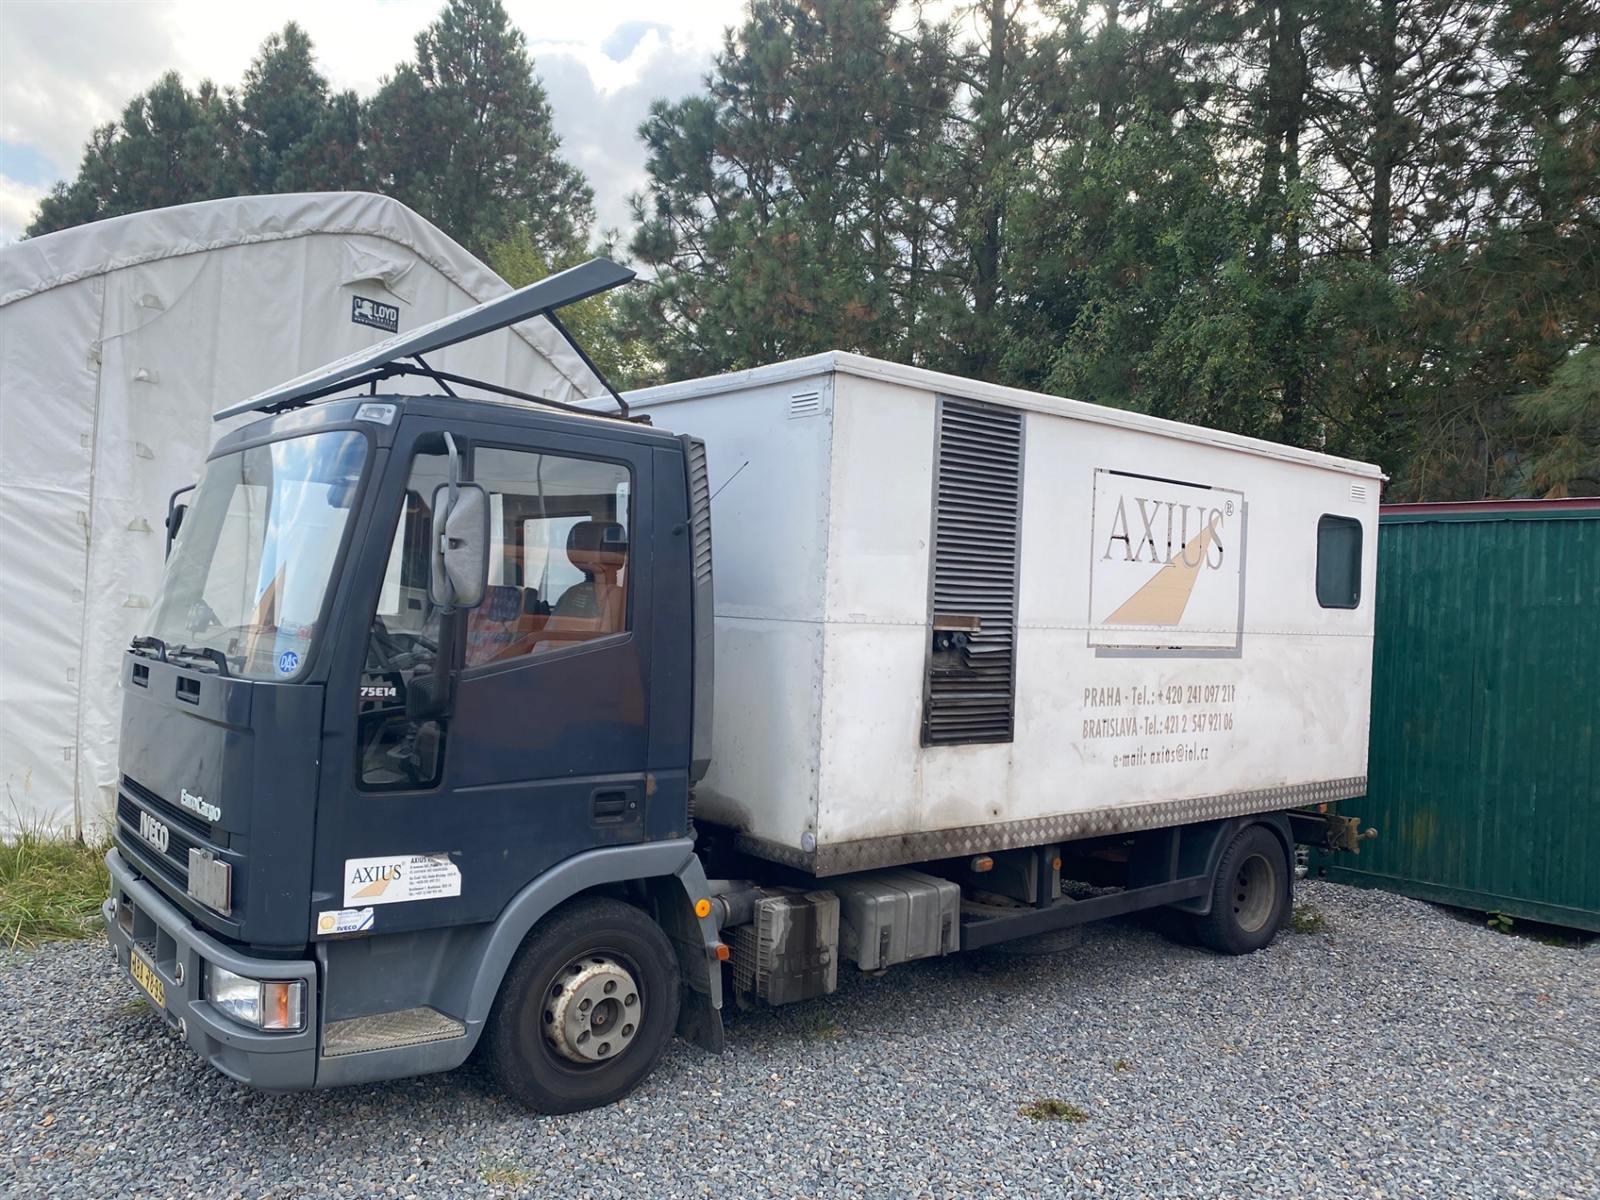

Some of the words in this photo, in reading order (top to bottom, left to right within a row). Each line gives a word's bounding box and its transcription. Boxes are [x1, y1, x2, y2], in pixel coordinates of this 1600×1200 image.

[373, 304, 397, 321] LOYD
[360, 687, 397, 697] 75E14
[1083, 687, 1121, 708] PRAHA
[1204, 685, 1220, 703] 097
[1083, 717, 1138, 739] BRATISLAVA
[1113, 745, 1147, 769] e-mail:
[140, 811, 169, 853] IVECO
[352, 864, 402, 884] AXIUS
